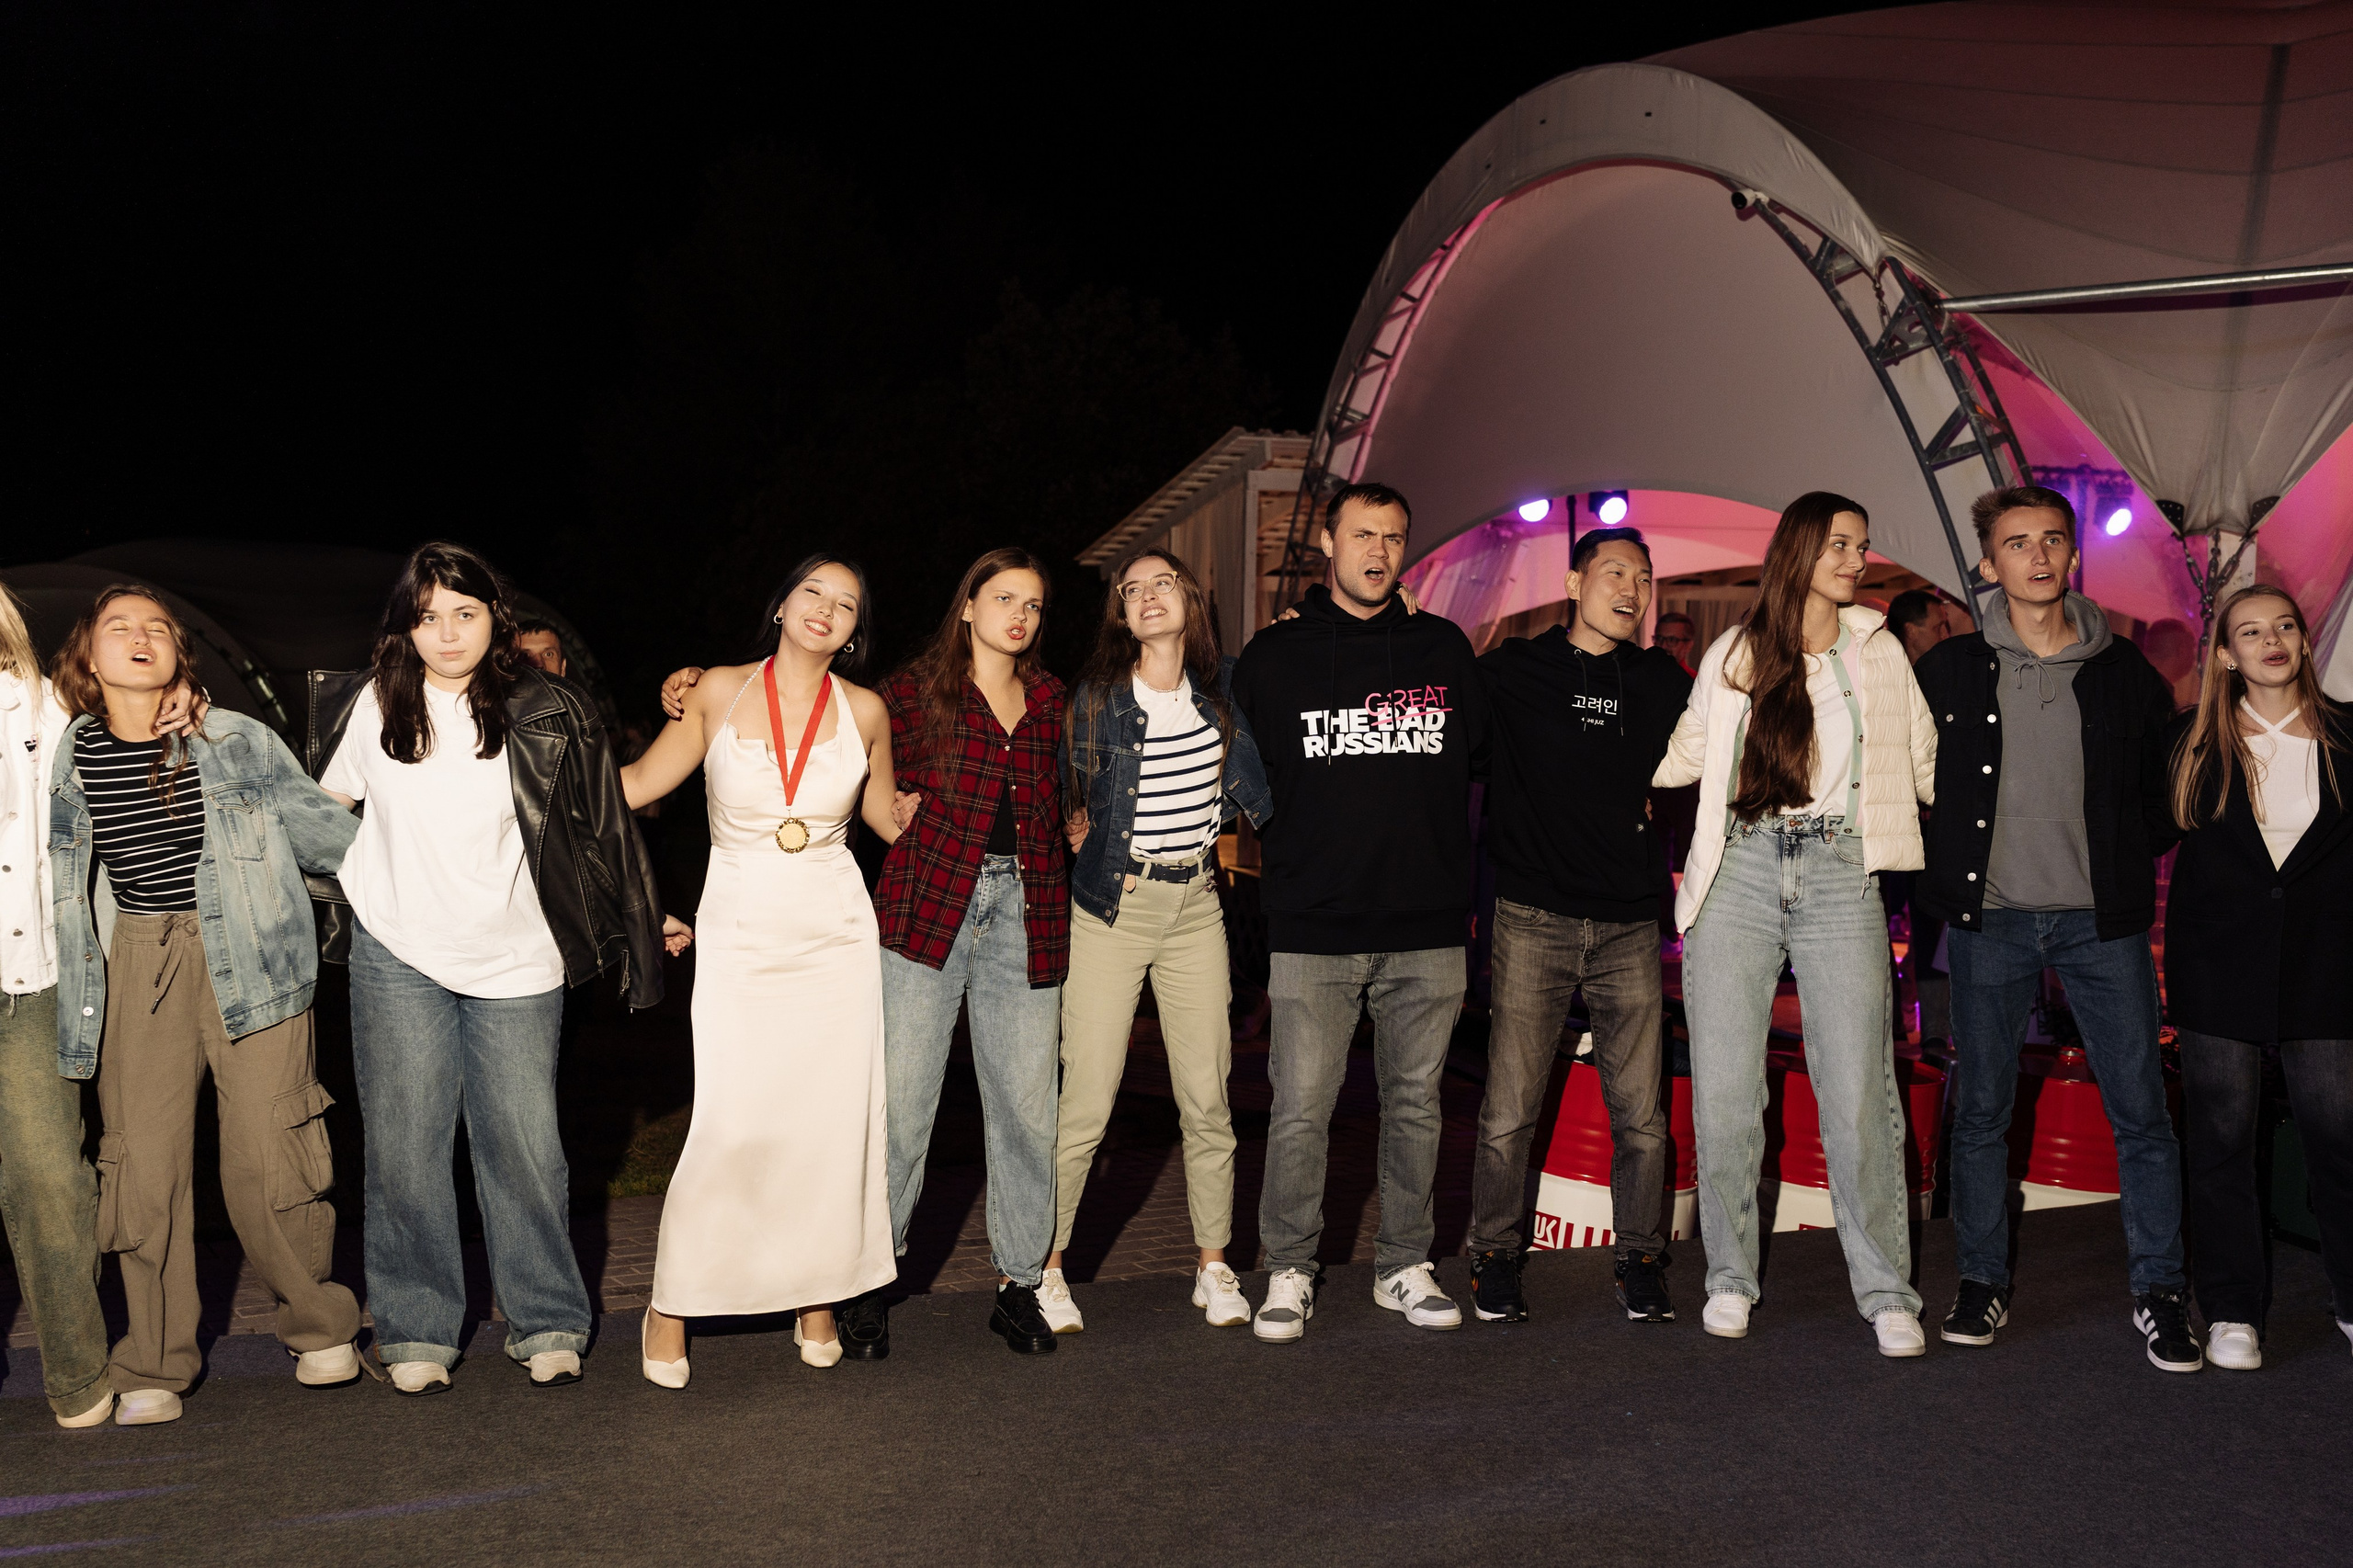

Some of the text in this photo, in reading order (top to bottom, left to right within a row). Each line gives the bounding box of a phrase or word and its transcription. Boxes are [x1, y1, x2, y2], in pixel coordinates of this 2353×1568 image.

[1364, 685, 1449, 716] GREAT
[1572, 694, 1618, 716] 고려인
[1300, 706, 1446, 736] THE BAD
[1302, 732, 1444, 758] RUSSIANS
[1390, 1280, 1411, 1302] N
